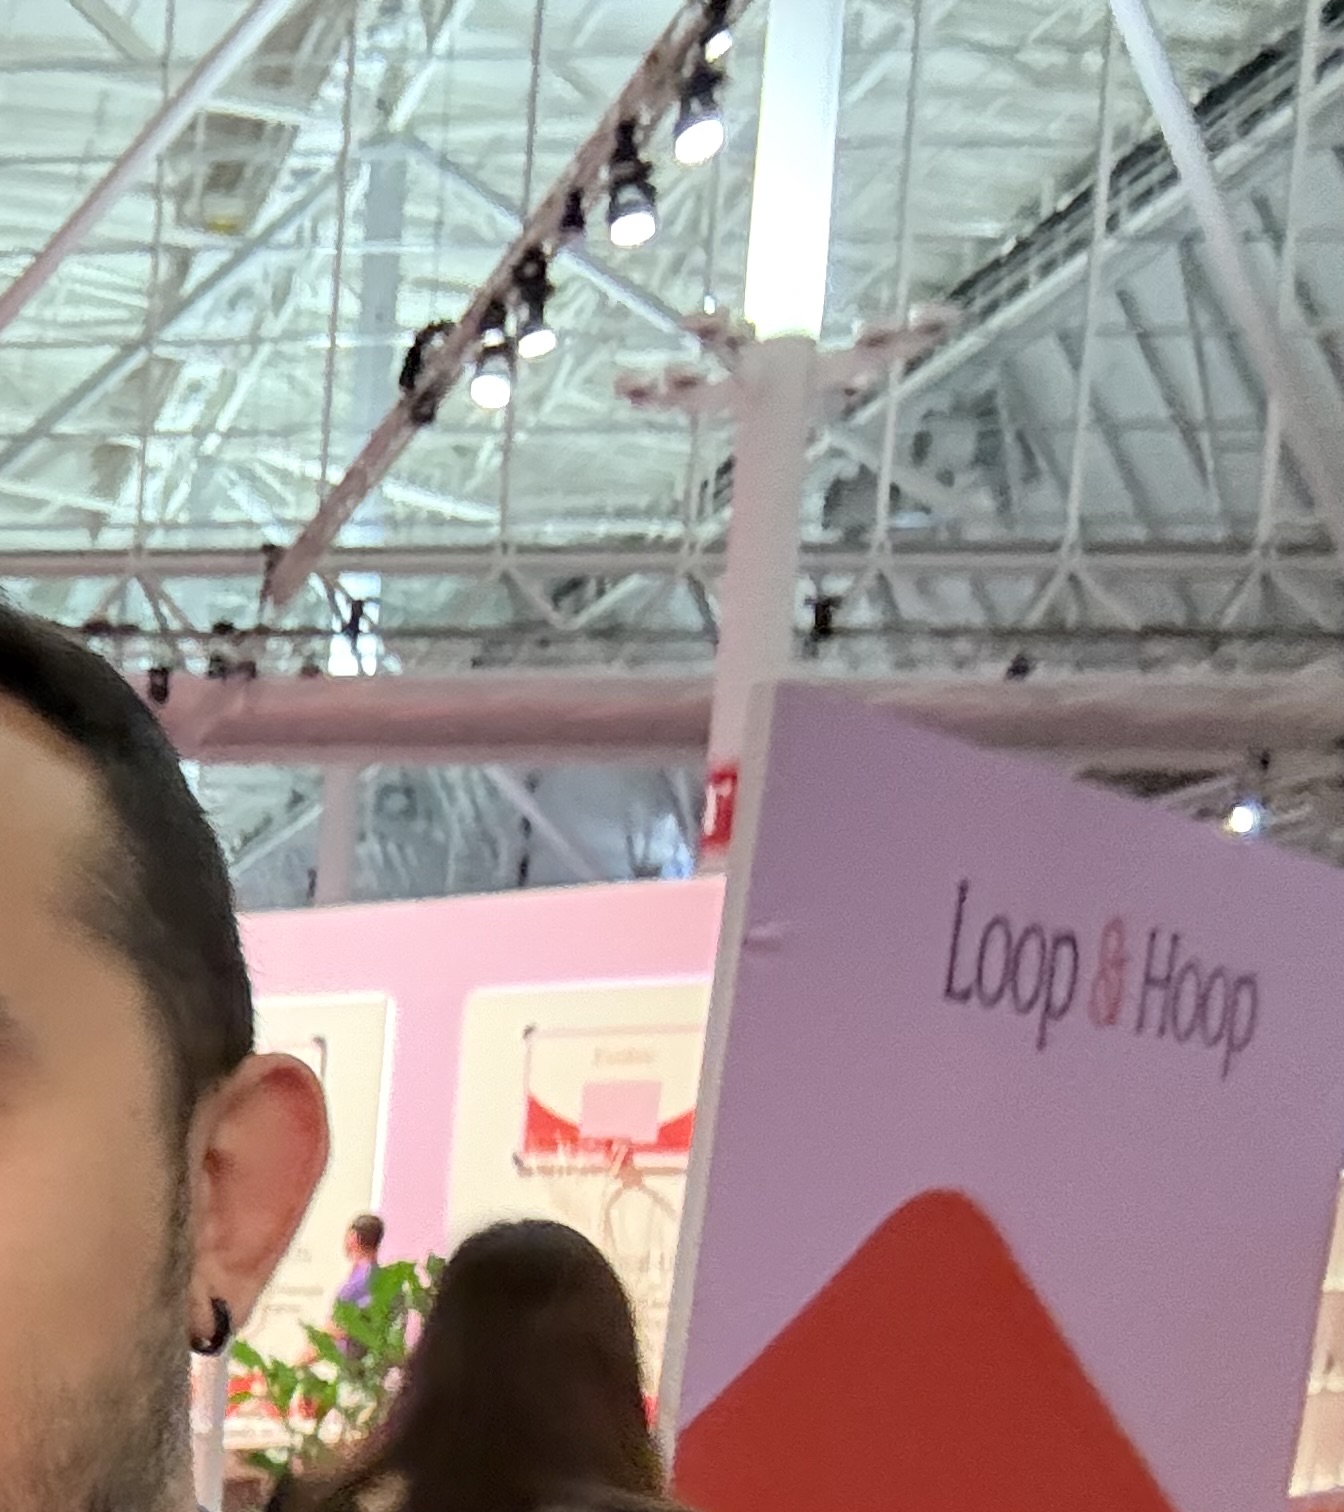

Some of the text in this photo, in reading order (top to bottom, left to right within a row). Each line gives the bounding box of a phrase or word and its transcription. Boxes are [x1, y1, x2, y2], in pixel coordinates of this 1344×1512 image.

[943, 878, 1258, 1082] Loop & Hoop
